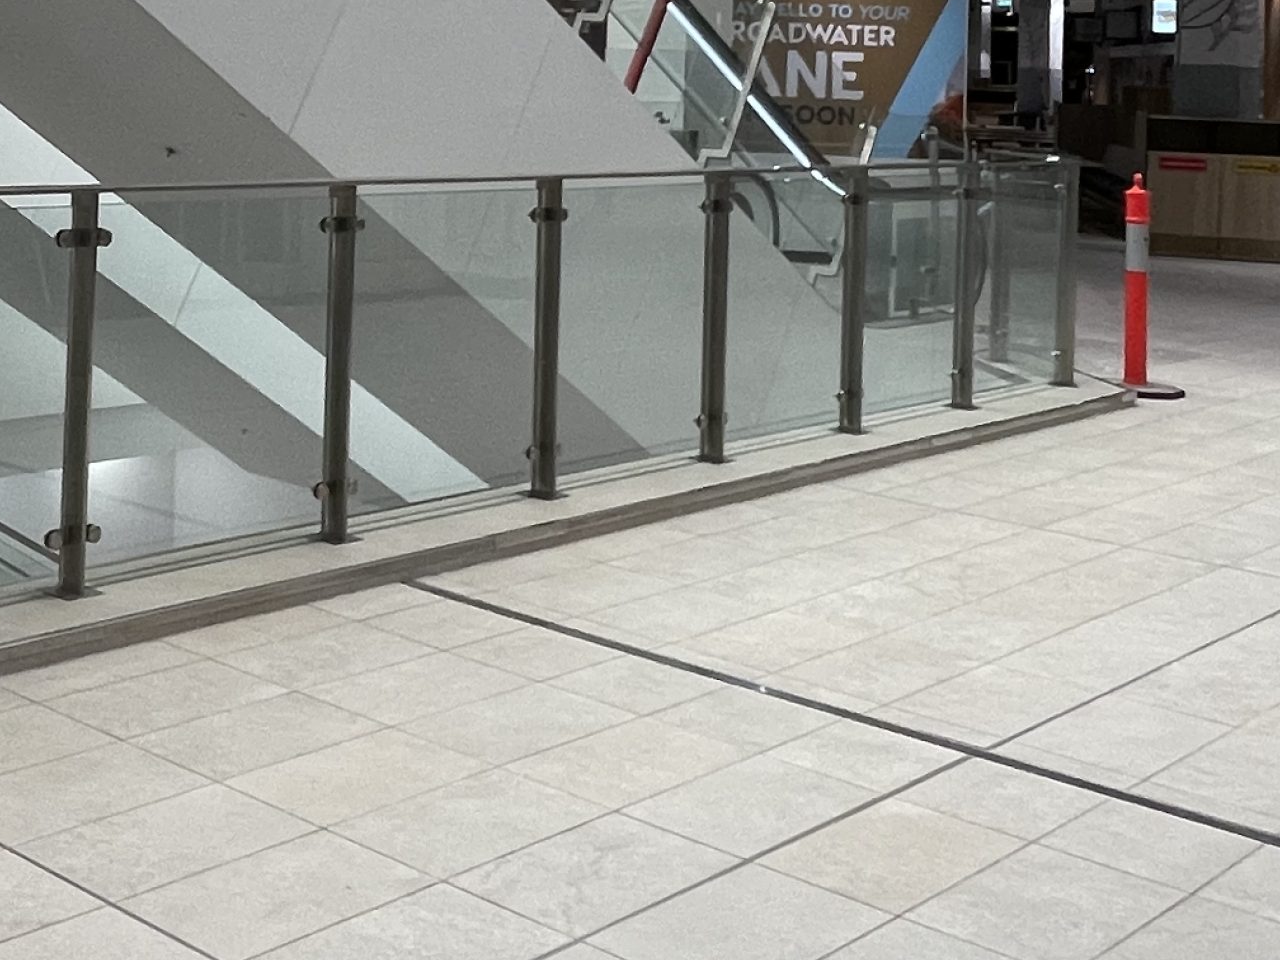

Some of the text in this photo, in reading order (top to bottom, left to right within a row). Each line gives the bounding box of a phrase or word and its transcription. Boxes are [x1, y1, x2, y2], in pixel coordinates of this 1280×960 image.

[735, 1, 910, 21] AY ELLO TO YOUR
[732, 21, 896, 47] ROADWATER
[756, 50, 865, 101] ANE
